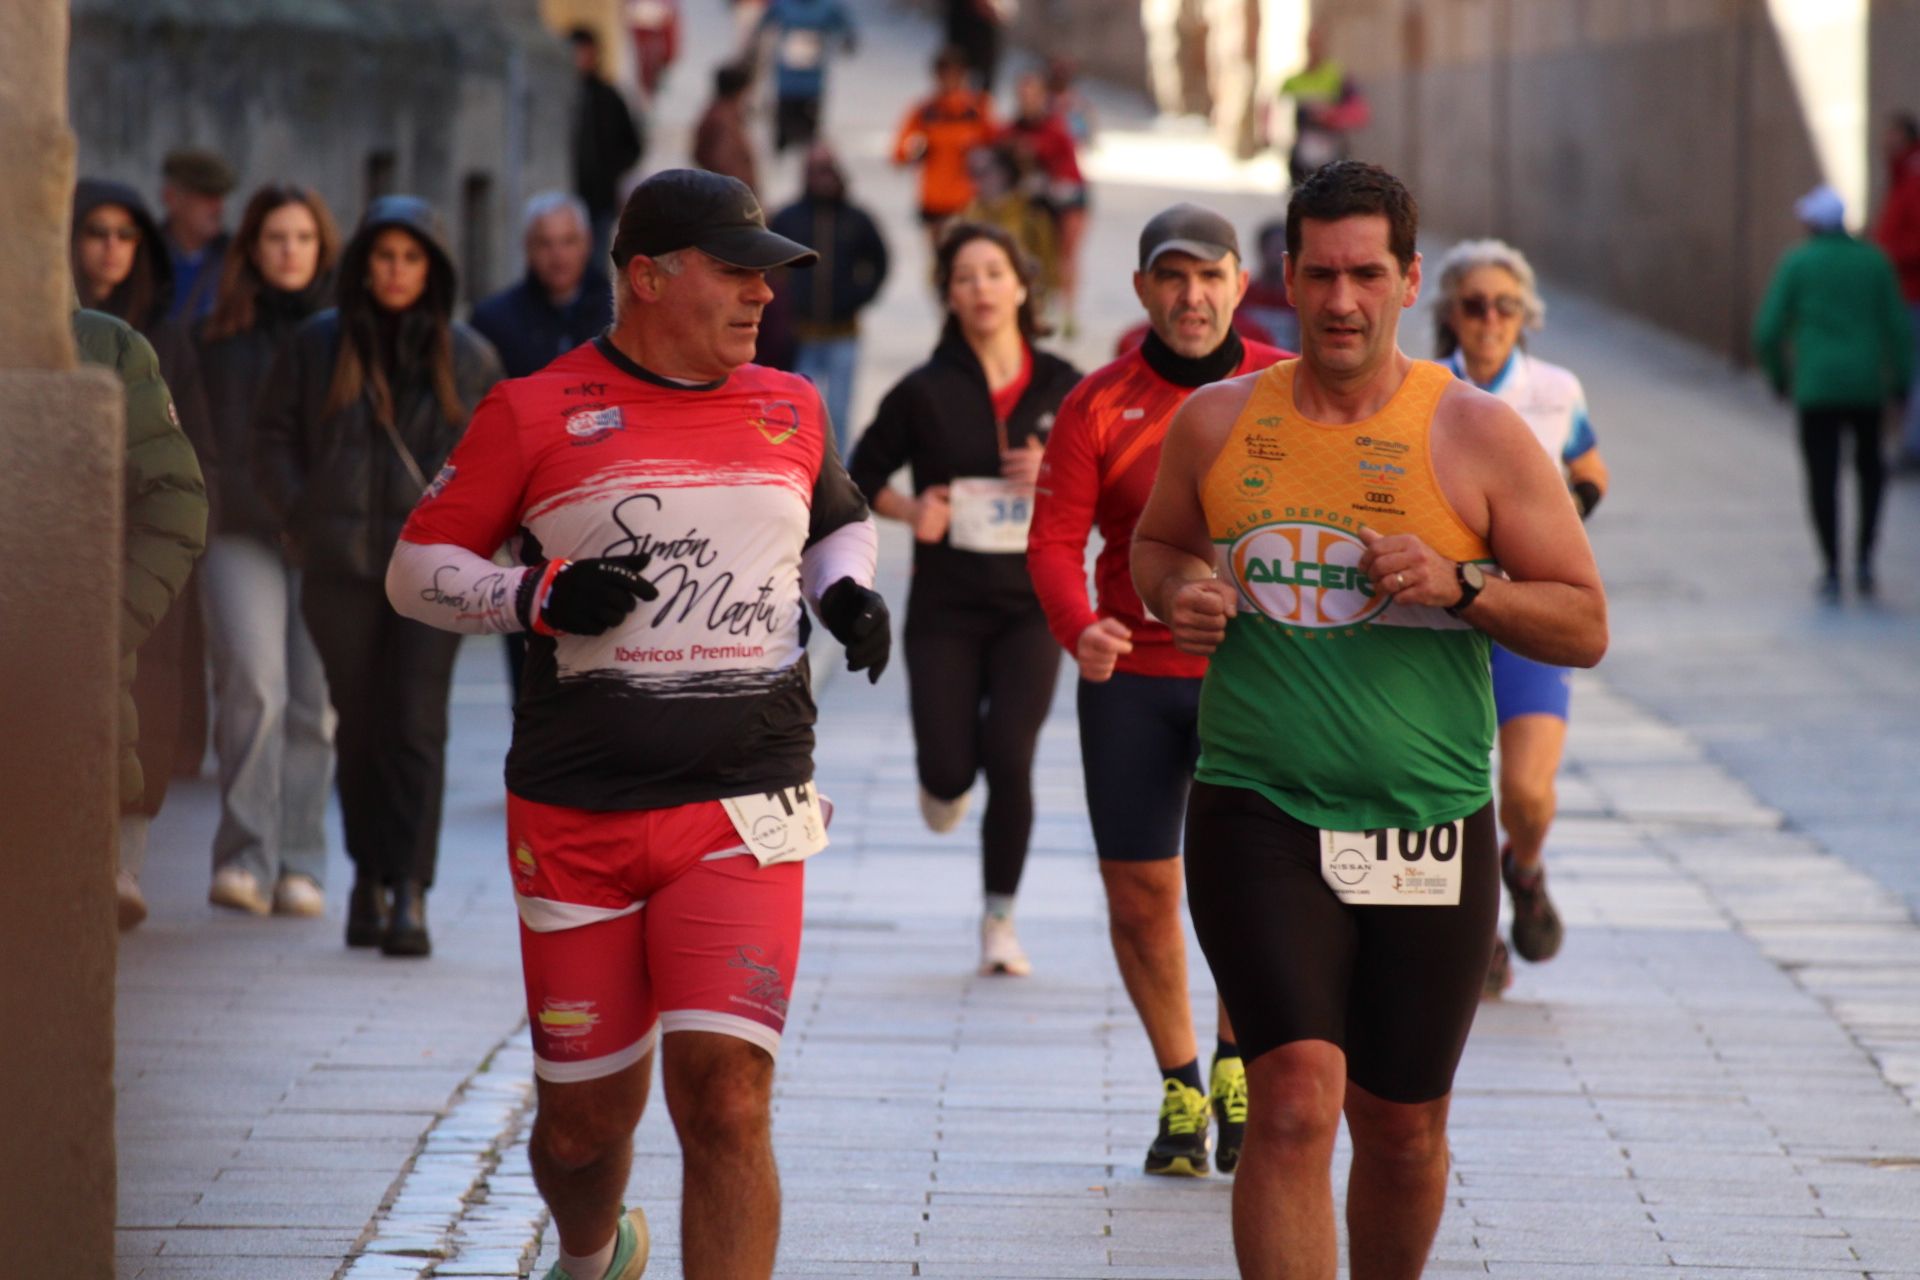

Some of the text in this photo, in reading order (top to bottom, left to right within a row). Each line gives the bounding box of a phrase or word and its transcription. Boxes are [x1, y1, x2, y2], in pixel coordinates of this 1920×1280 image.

[602, 494, 717, 567] Simón
[1226, 508, 1272, 537] CLUB
[614, 643, 764, 662] Ibéricos Premium
[1364, 820, 1458, 862] 100
[1329, 863, 1372, 871] NISSAN
